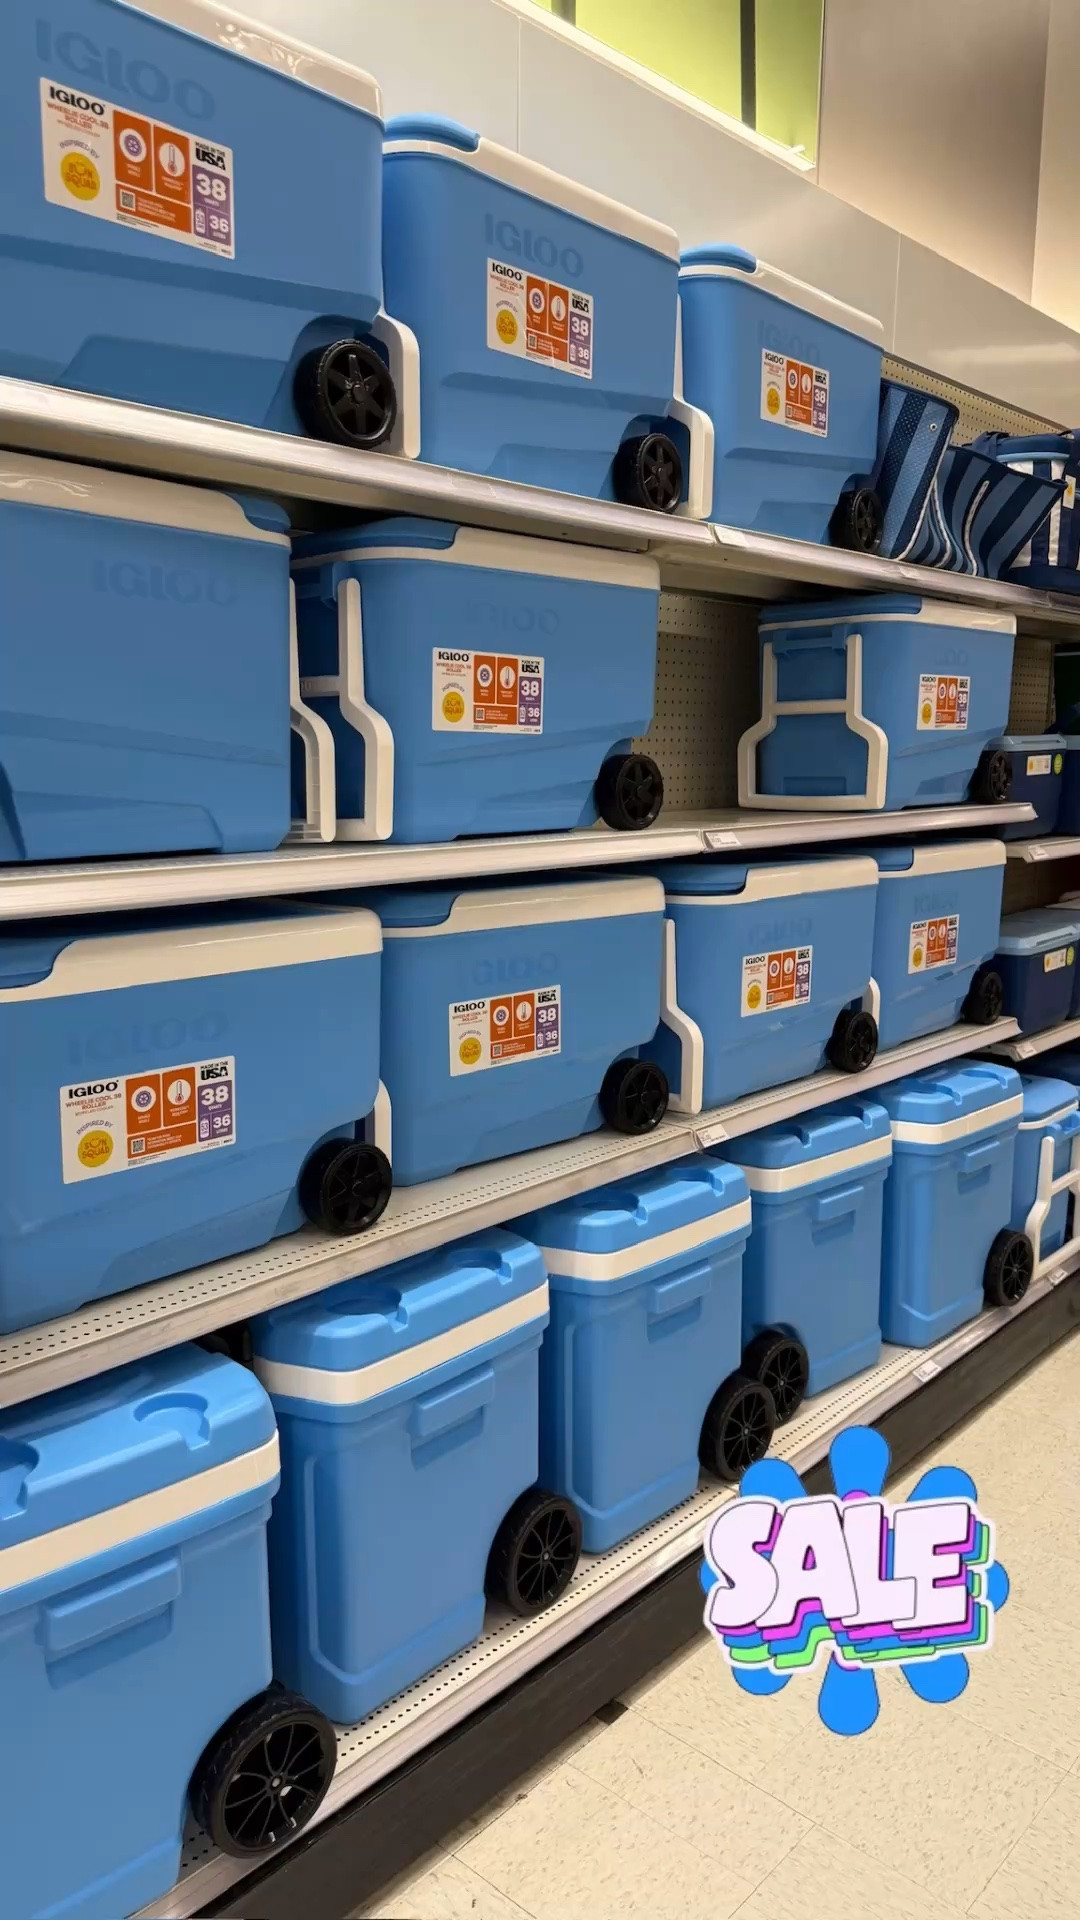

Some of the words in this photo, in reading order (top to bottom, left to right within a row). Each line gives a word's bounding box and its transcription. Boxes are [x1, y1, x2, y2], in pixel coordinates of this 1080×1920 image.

[35, 18, 215, 120] IGLOO
[49, 86, 105, 115] IGLOO
[195, 147, 226, 171] USA
[196, 173, 226, 201] 38
[209, 214, 230, 234] 36
[484, 212, 585, 279] IGLOO
[492, 262, 522, 281] IGLOO
[571, 298, 590, 314] USA
[571, 316, 589, 337] 38
[578, 346, 590, 360] 36
[764, 352, 784, 365] IGLOO
[814, 388, 826, 404] 38
[438, 651, 470, 662] IGLOO
[521, 664, 540, 674] USA
[521, 680, 540, 697] 38
[527, 707, 540, 718] 36
[745, 955, 766, 965] IGLOO
[796, 963, 809, 976] 38
[537, 993, 556, 1003] USA
[454, 1001, 485, 1014] IGLOO
[538, 1007, 557, 1023] 38
[545, 1030, 558, 1041] 36
[200, 1066, 229, 1081] USA
[68, 1081, 118, 1099] IGLOO
[201, 1085, 229, 1106] 38
[65, 1098, 95, 1108] WHEELIE
[95, 1095, 112, 1103] COOL
[81, 1101, 107, 1110] ROLLER
[76, 1119, 105, 1135] INSPIRED
[104, 1120, 114, 1128] BY
[213, 1114, 231, 1129] 36
[82, 1146, 110, 1160] SQUAD
